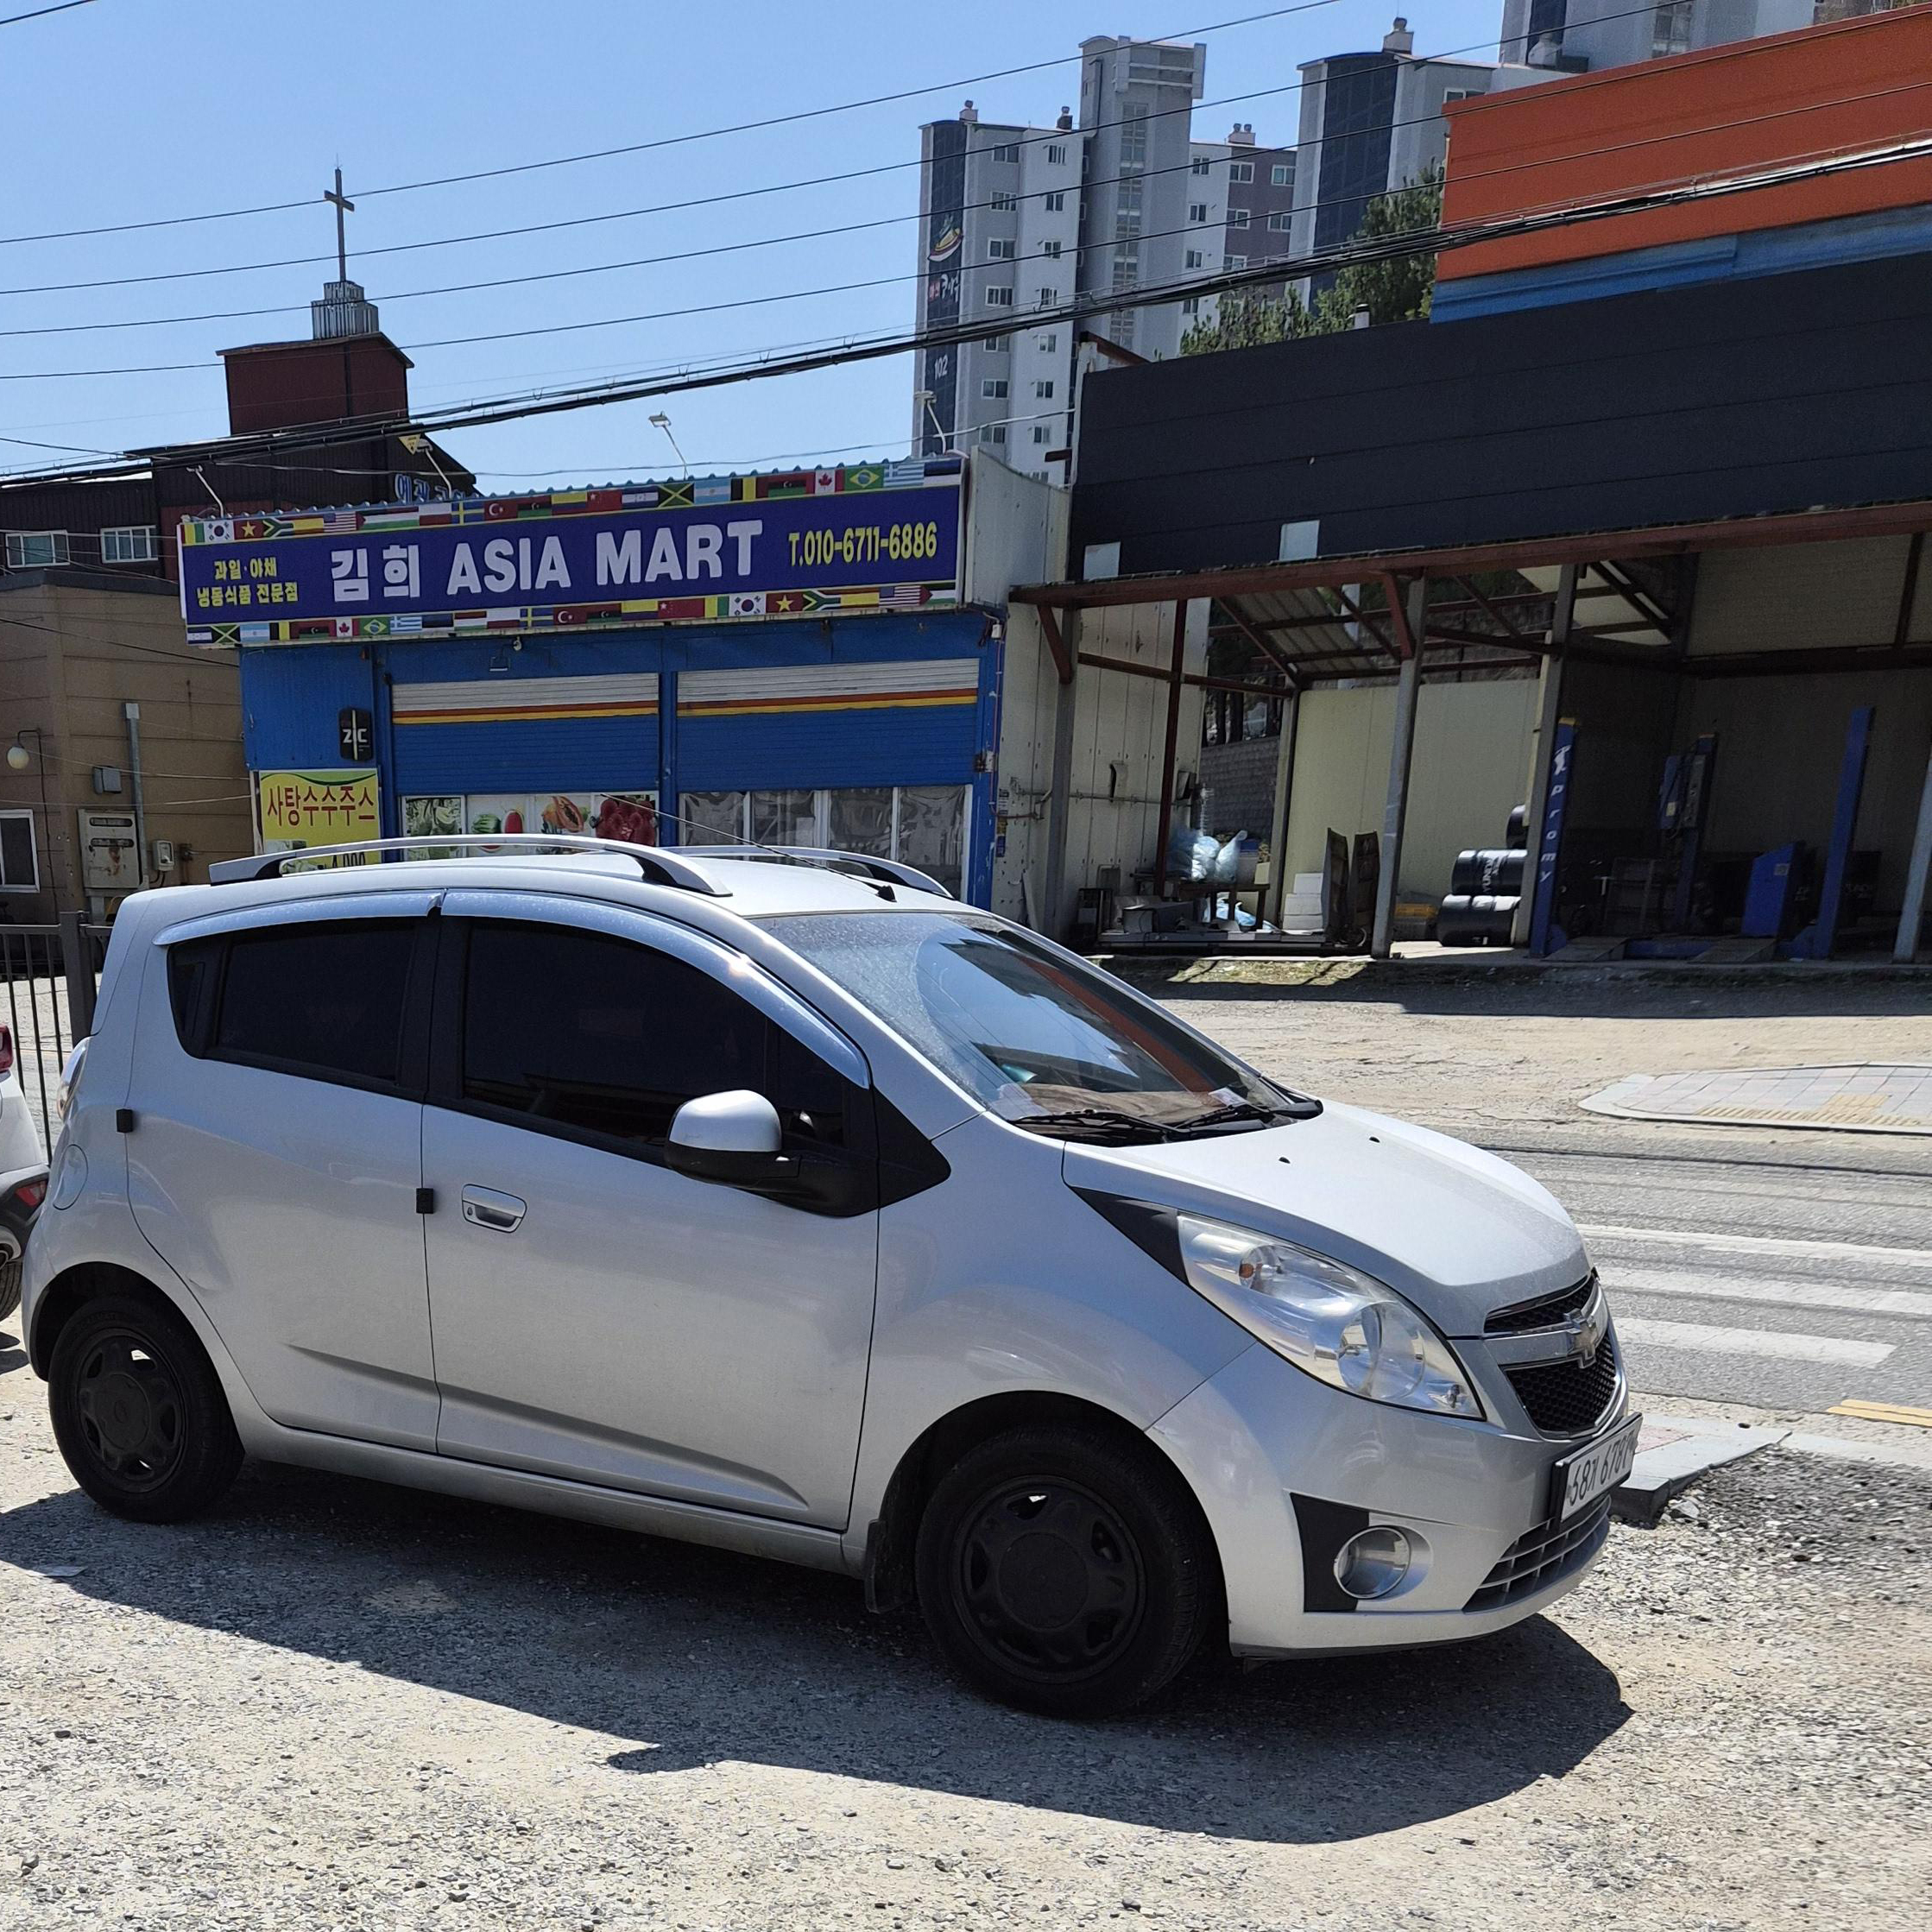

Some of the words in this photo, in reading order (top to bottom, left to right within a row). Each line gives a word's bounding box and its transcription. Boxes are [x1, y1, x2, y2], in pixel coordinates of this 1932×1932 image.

[934, 354, 949, 381] 102
[446, 535, 572, 596] ASIA
[596, 519, 764, 586] MART
[788, 521, 938, 567] T.010-6711-6886
[197, 584, 251, 608] 냉동식품
[256, 582, 299, 603] 전문점
[268, 785, 376, 827] 사탕수수주스
